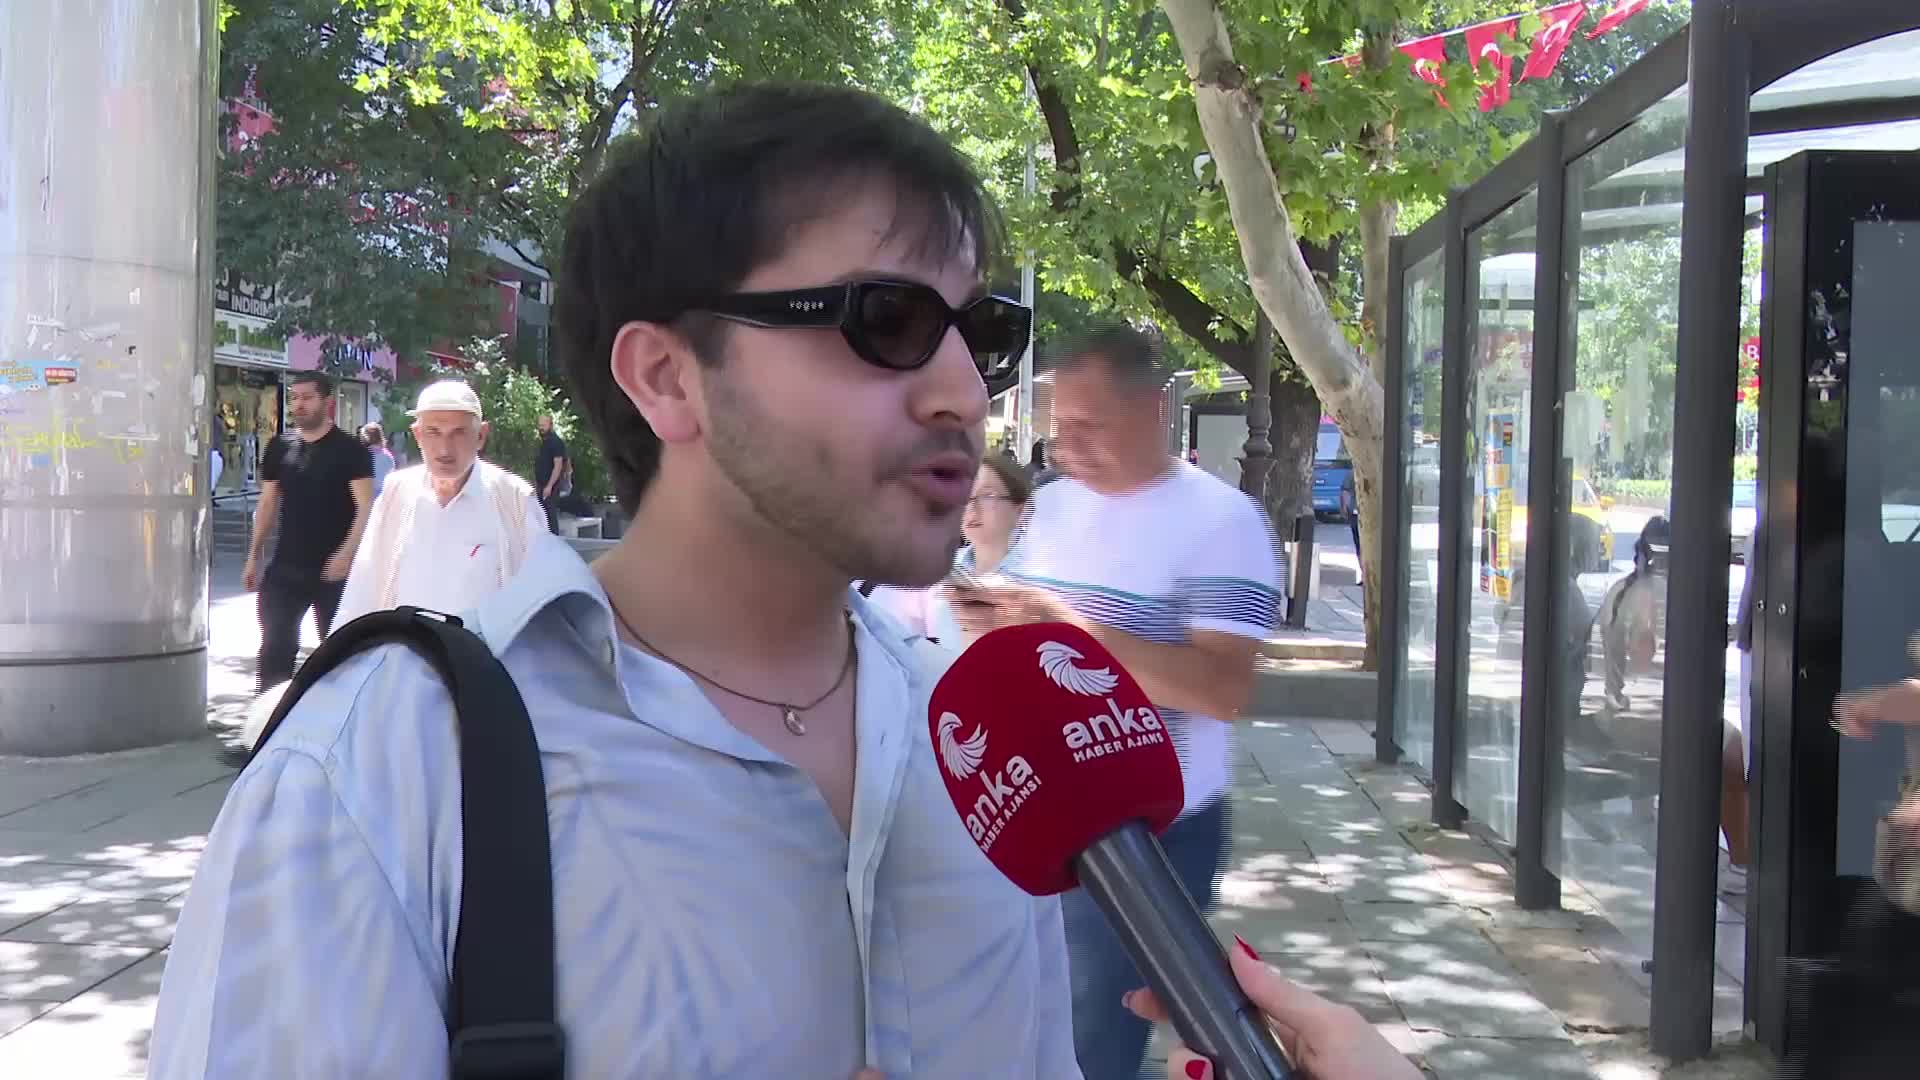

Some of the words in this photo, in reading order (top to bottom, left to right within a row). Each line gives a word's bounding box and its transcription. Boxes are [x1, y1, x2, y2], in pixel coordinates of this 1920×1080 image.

[1062, 698, 1162, 749] anka
[1073, 741, 1124, 762] HABER
[966, 755, 1033, 840] anka
[1004, 775, 1042, 821] AJANSI
